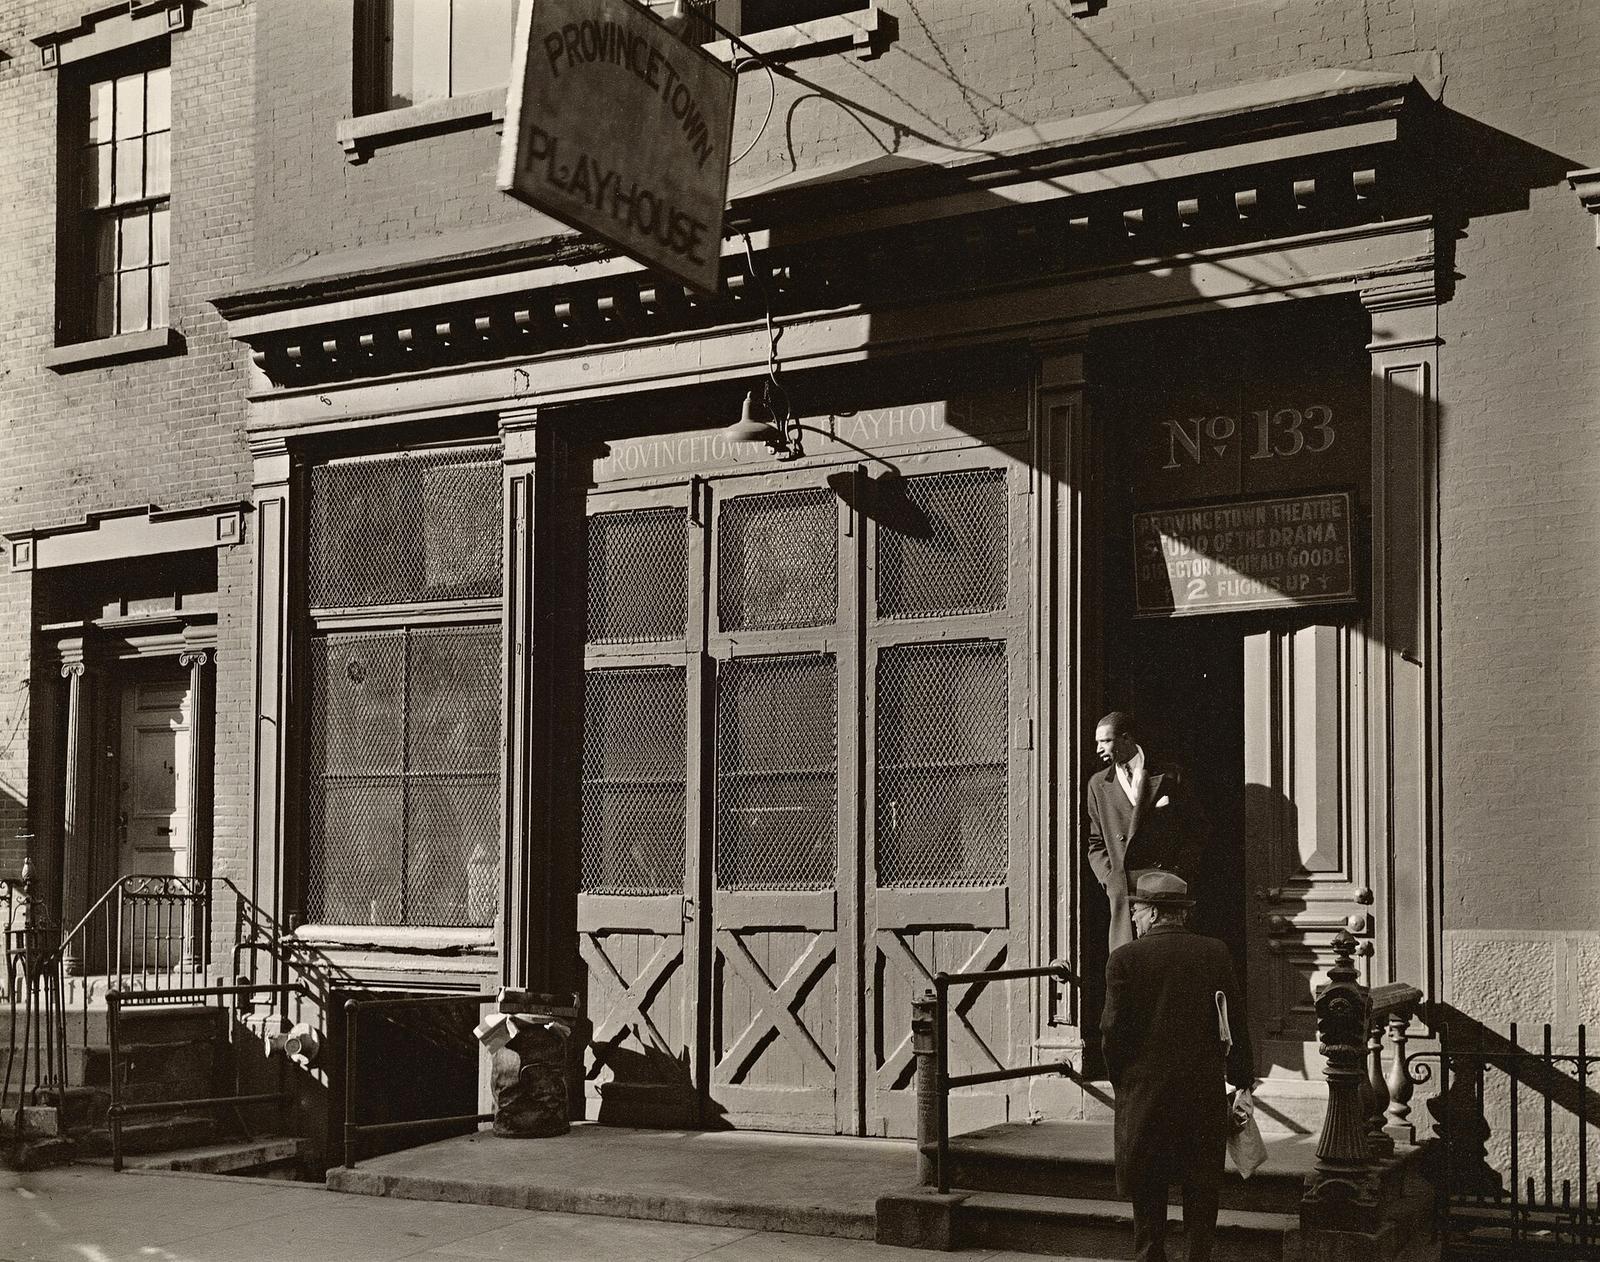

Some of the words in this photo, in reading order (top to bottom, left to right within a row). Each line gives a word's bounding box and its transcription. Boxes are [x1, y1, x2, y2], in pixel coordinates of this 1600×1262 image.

[544, 19, 713, 169] PROVINCETOWN
[525, 124, 708, 265] PLAYHOUSE
[820, 399, 978, 447] PLAYHOU
[1249, 405, 1335, 460] 133
[1272, 500, 1342, 522] THEATRE
[1213, 532, 1234, 552] OF
[1238, 530, 1265, 550] THE
[1269, 523, 1337, 548] DRAMA
[1287, 546, 1346, 568] GOODE
[1186, 578, 1210, 600] 2
[1217, 576, 1281, 598] FLIGHTS
[1286, 574, 1311, 591] UP
